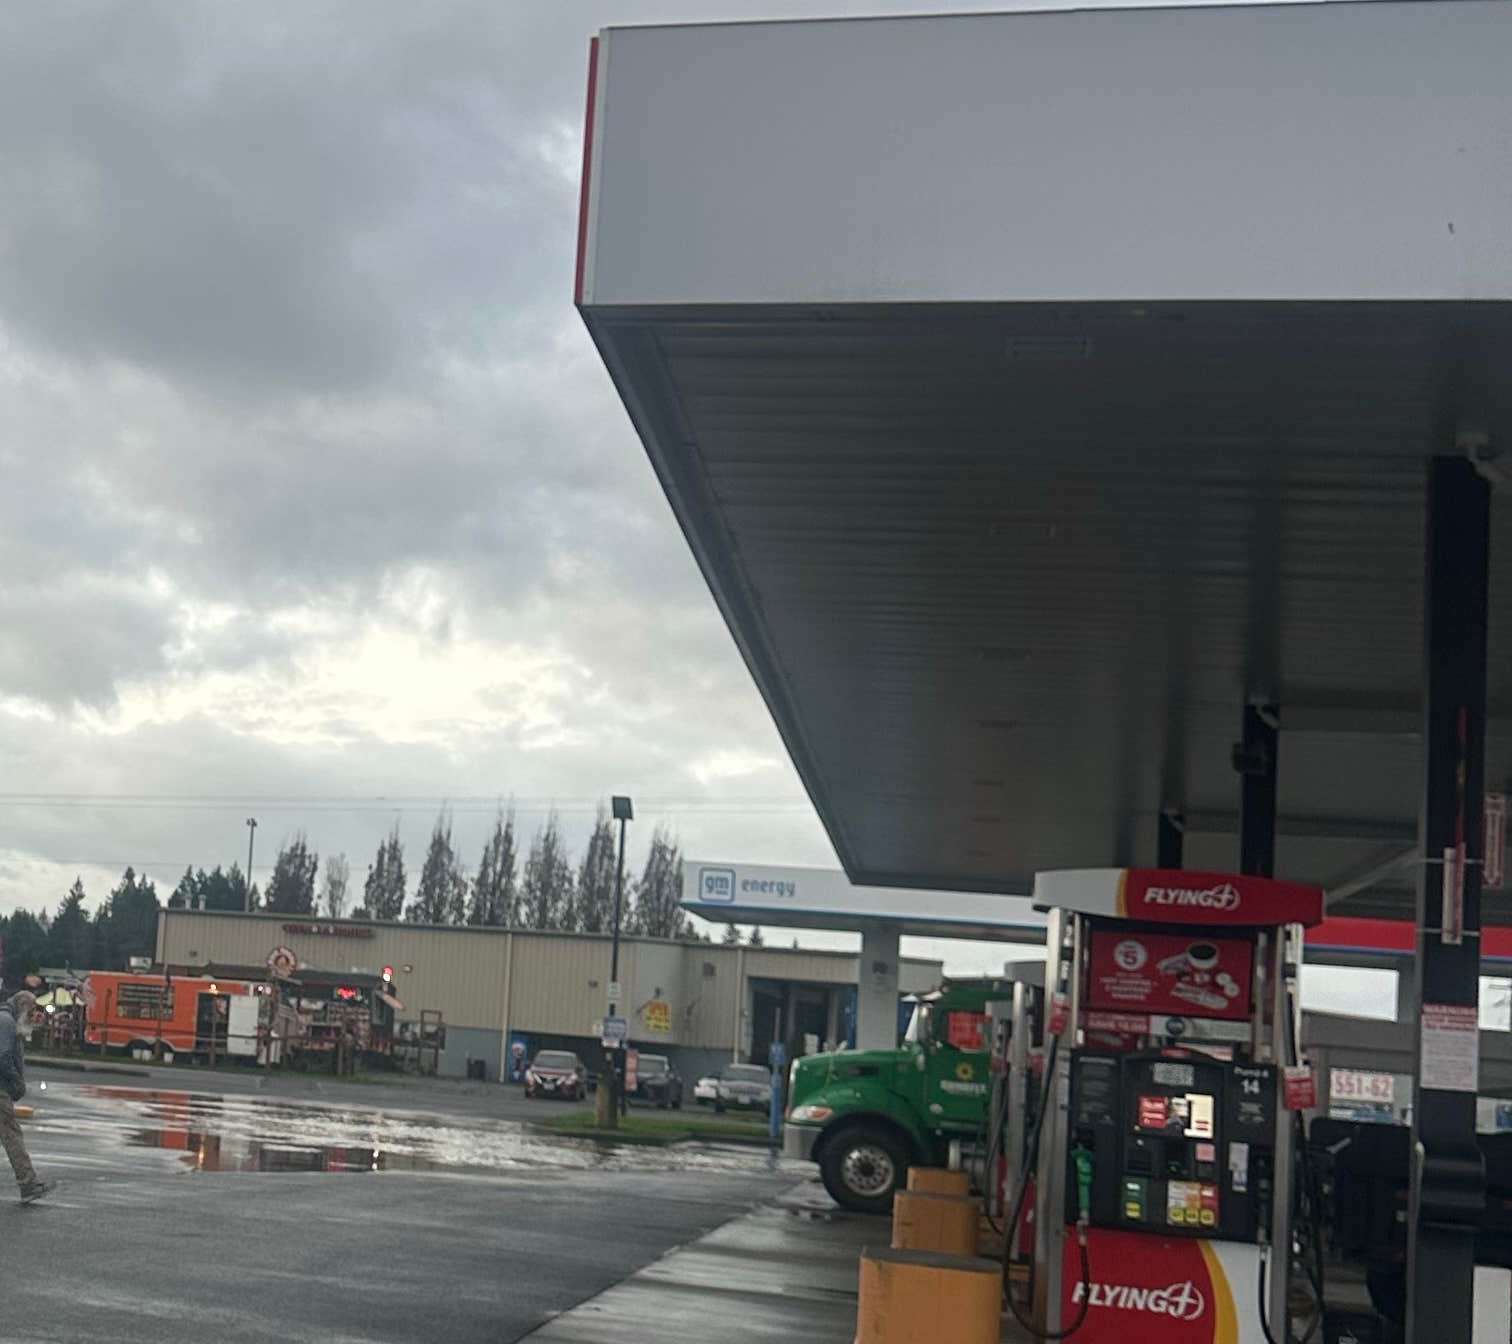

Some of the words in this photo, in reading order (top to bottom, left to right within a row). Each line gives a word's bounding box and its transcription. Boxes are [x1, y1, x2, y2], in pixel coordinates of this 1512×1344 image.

[704, 875, 730, 894] gm
[740, 878, 796, 897] energy
[1240, 1078, 1260, 1094] 14
